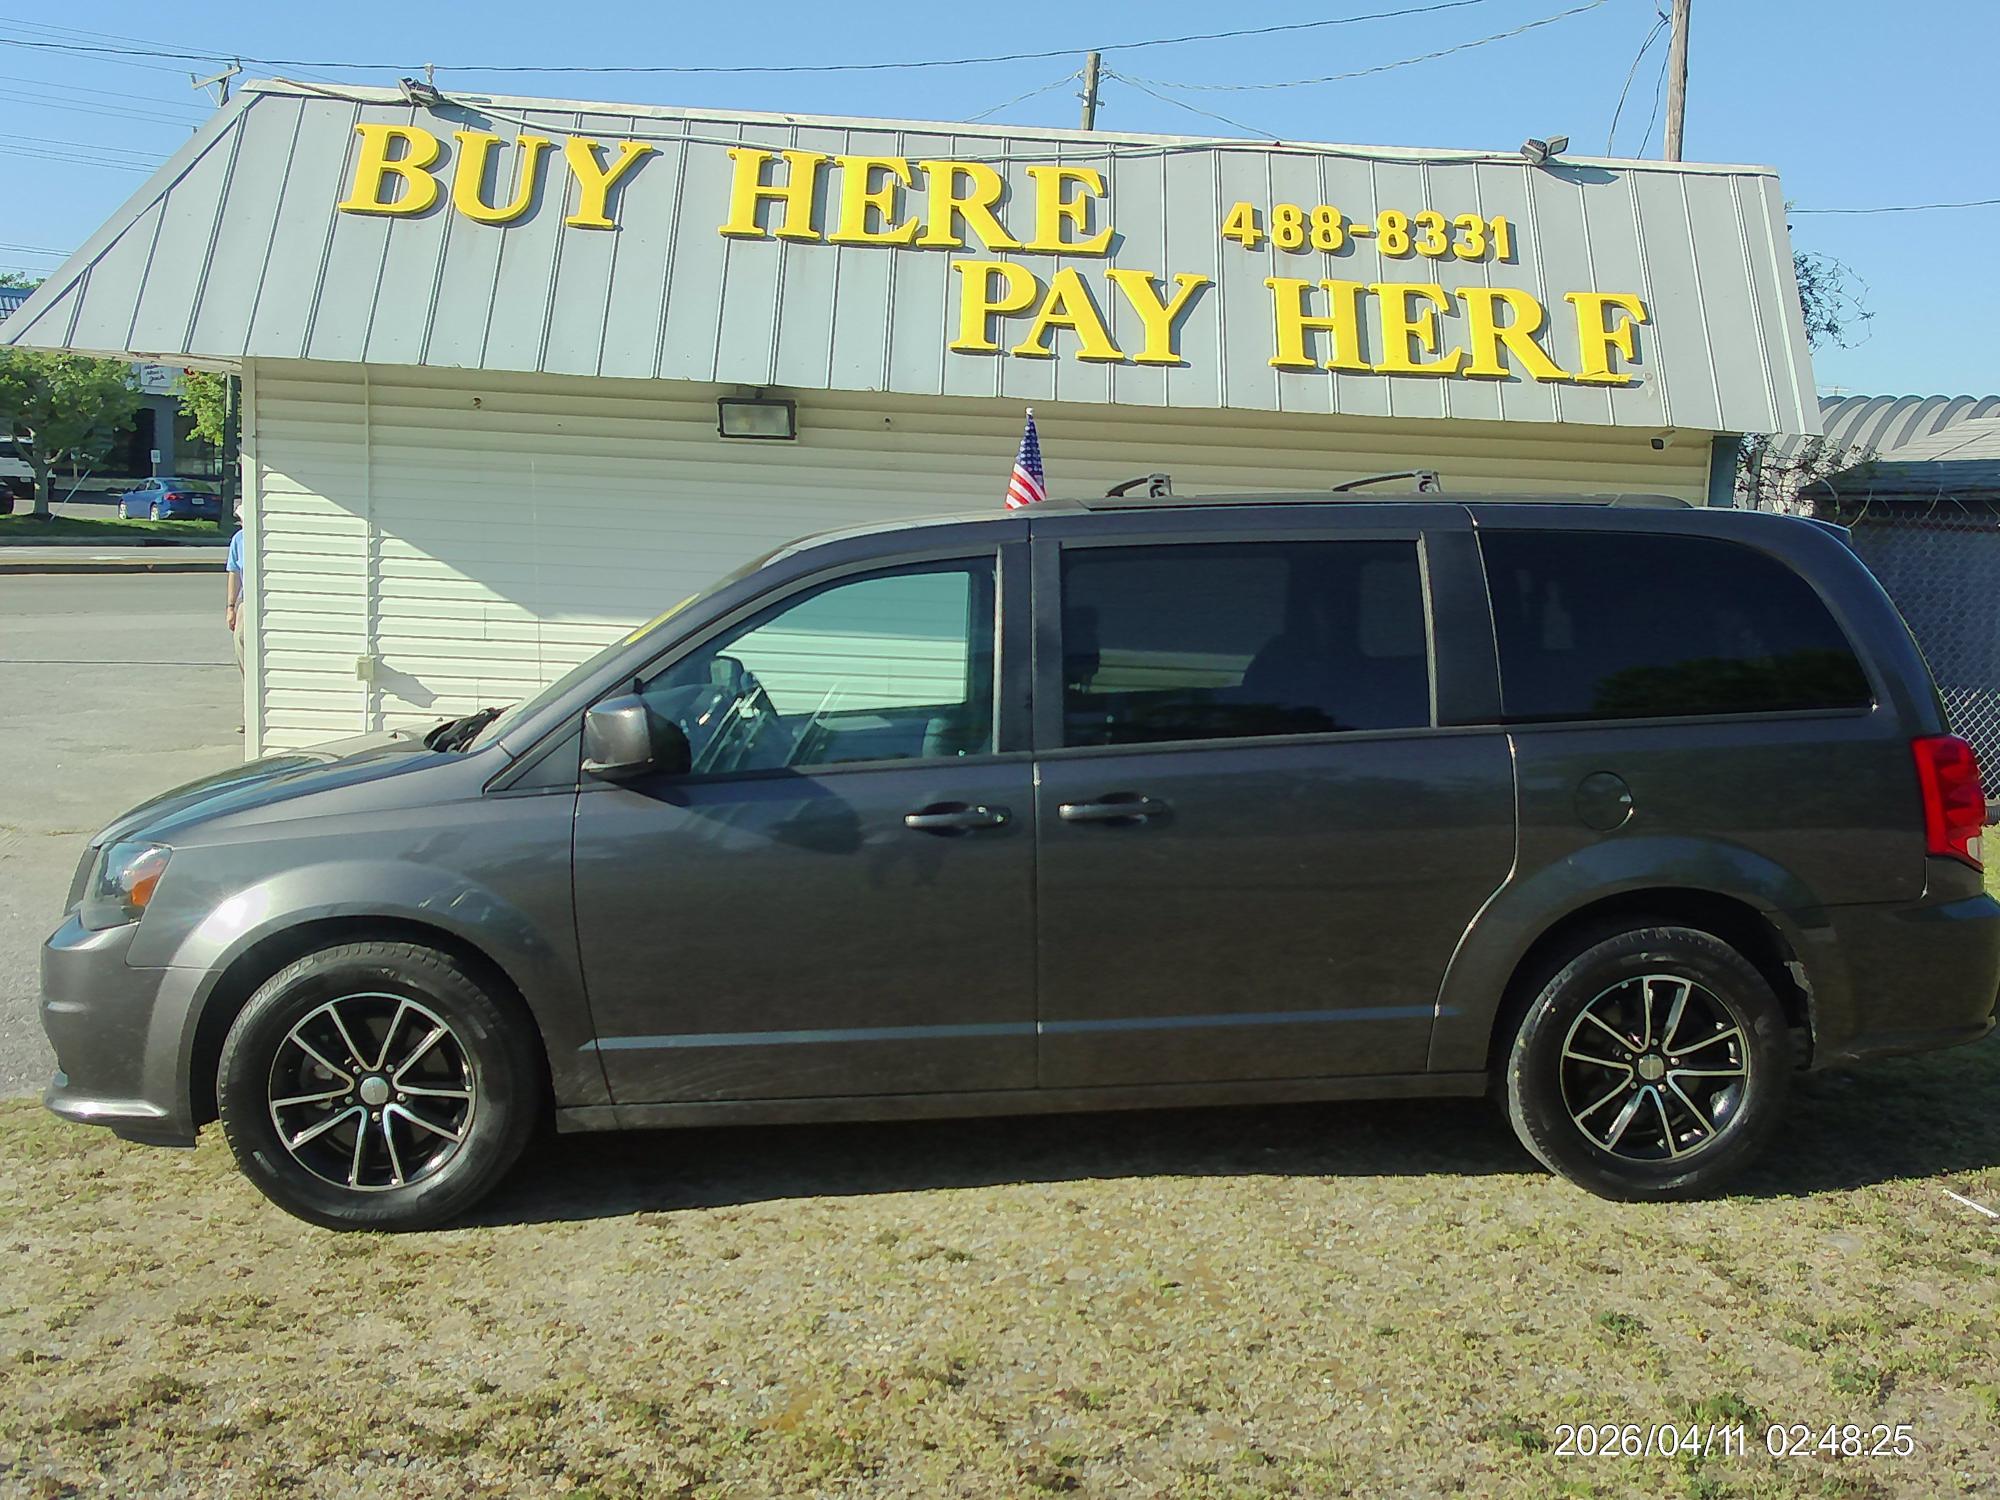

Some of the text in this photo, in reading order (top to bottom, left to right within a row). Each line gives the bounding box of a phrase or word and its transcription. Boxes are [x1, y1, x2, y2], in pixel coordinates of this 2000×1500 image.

[338, 123, 1115, 254] BUY HERE
[1222, 201, 1513, 261] 488-8331
[949, 260, 1208, 363] PAY
